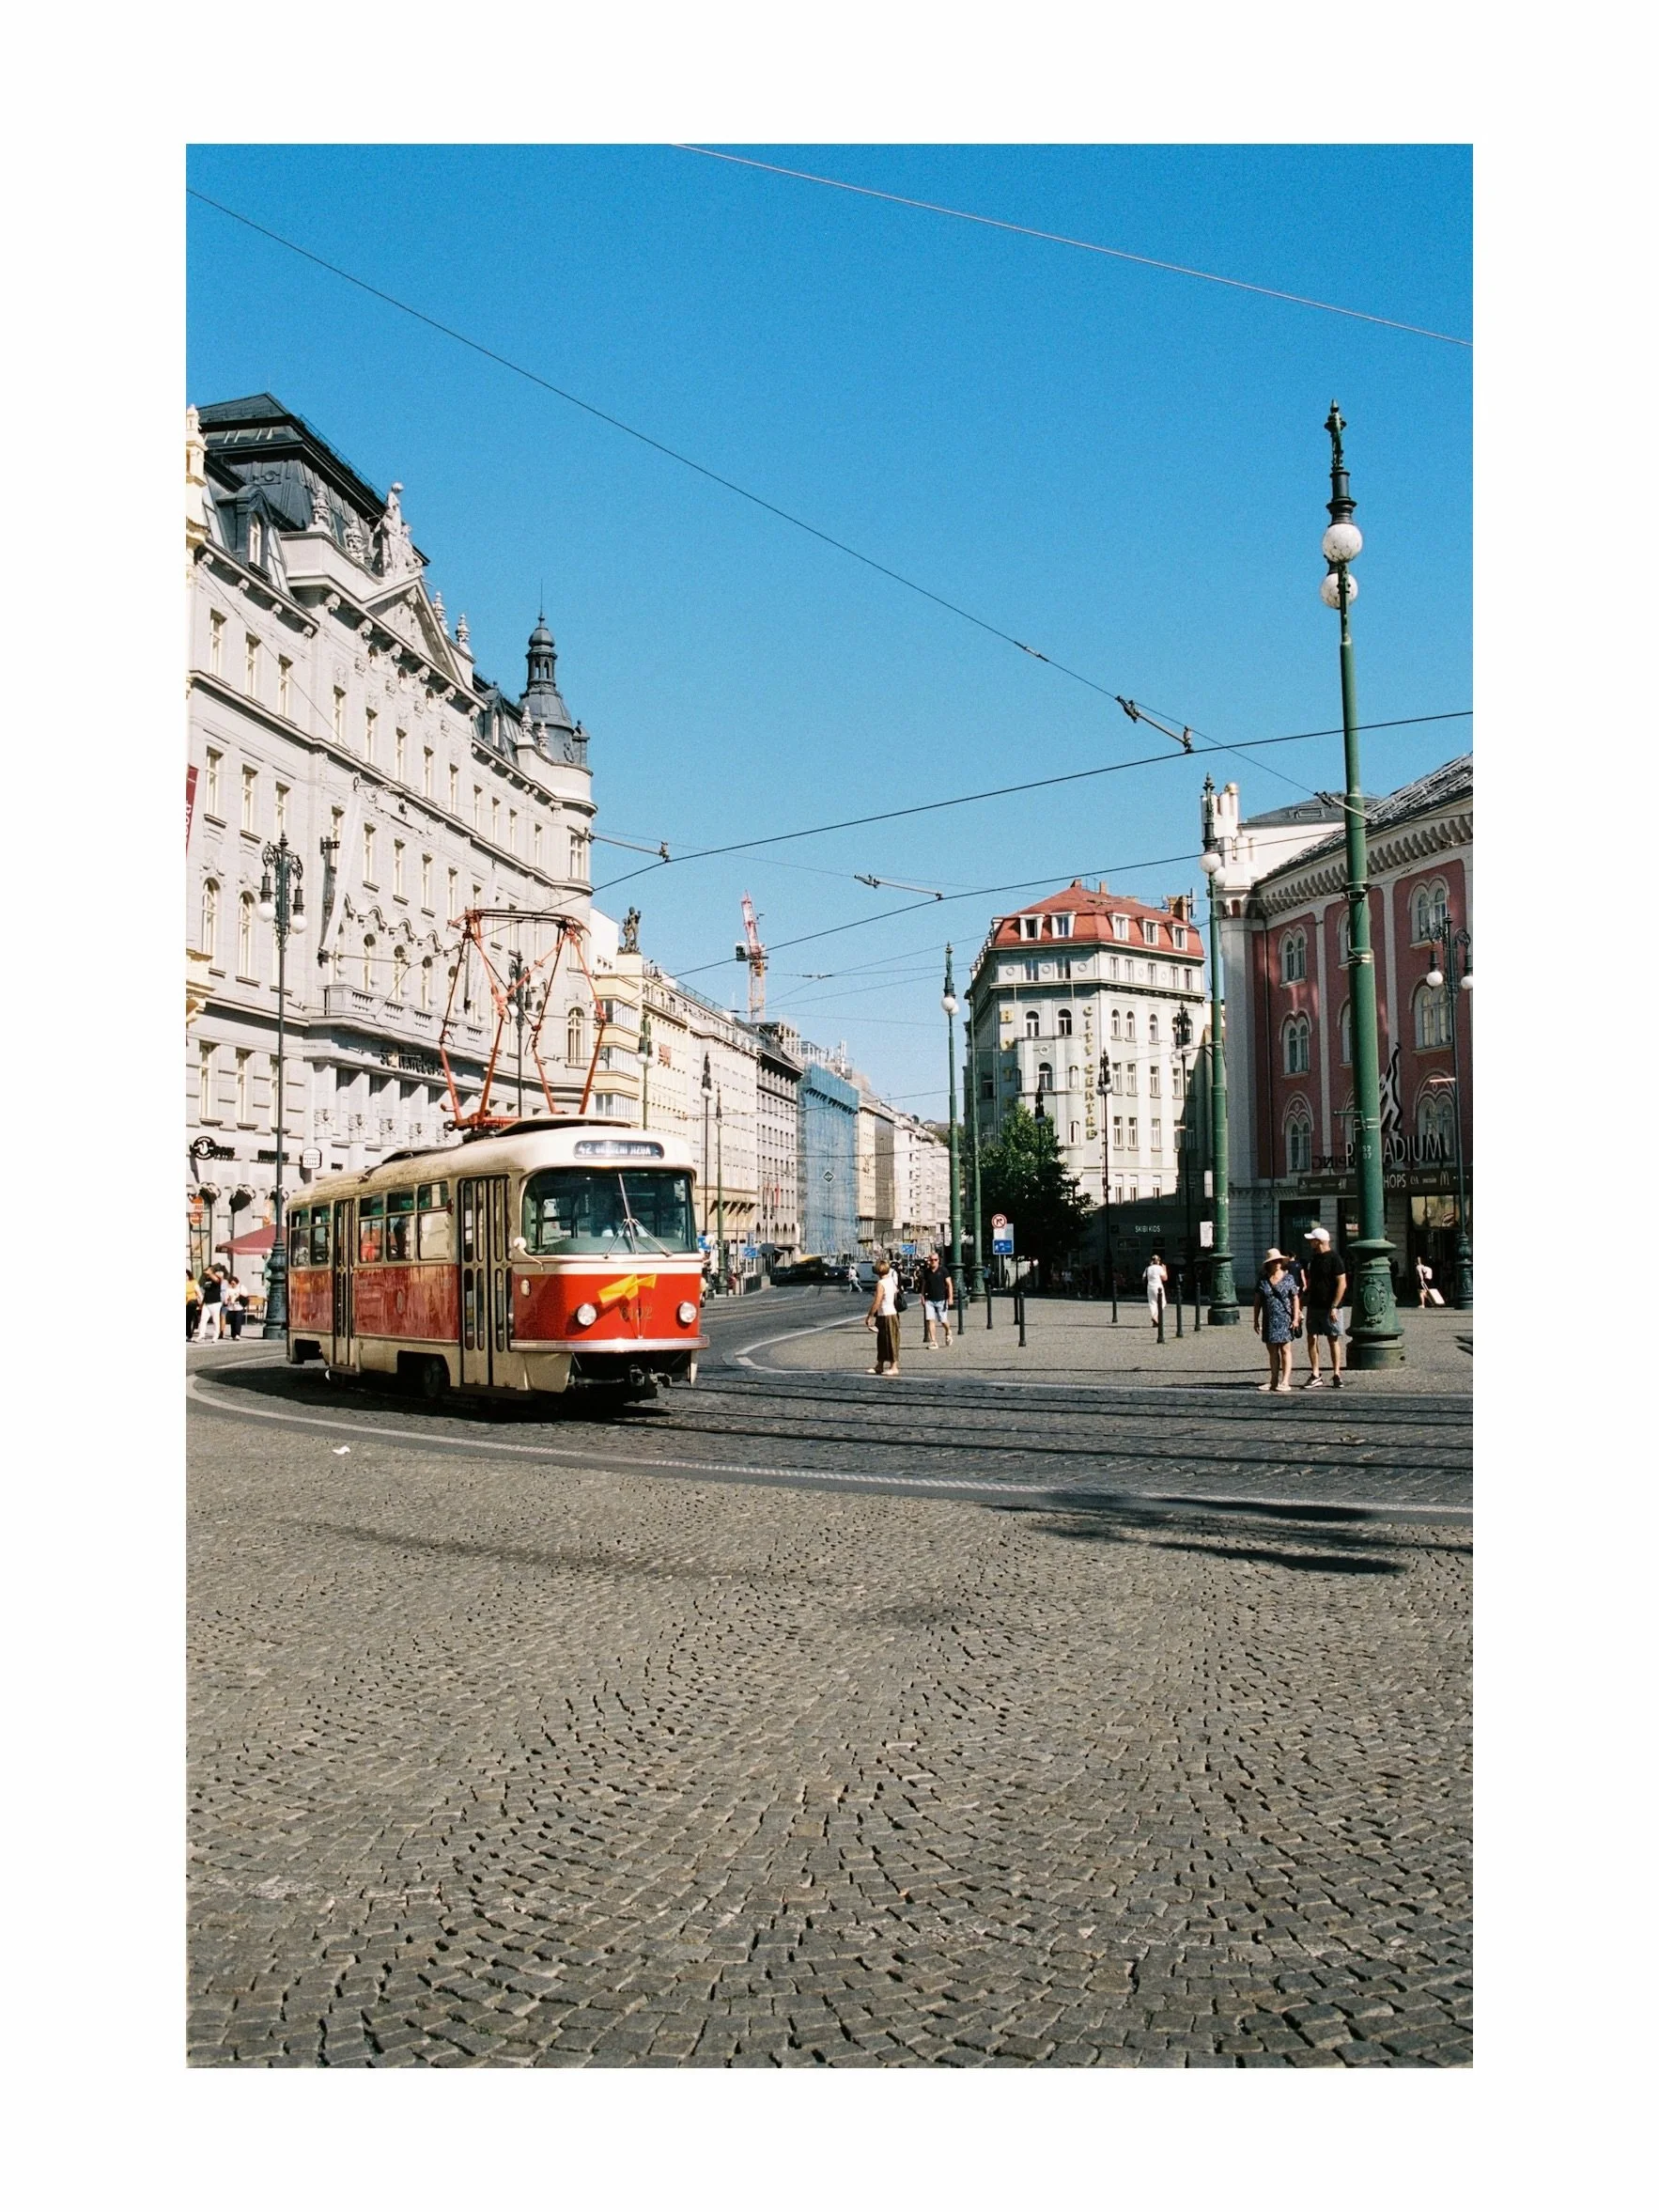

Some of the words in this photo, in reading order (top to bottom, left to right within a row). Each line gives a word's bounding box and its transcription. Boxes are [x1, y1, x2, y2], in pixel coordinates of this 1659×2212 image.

[1083, 1006, 1093, 1056] CITY
[1084, 1064, 1097, 1140] CENTRE
[1346, 1133, 1443, 1167] PADIUM
[1384, 1174, 1406, 1189] HOPS
